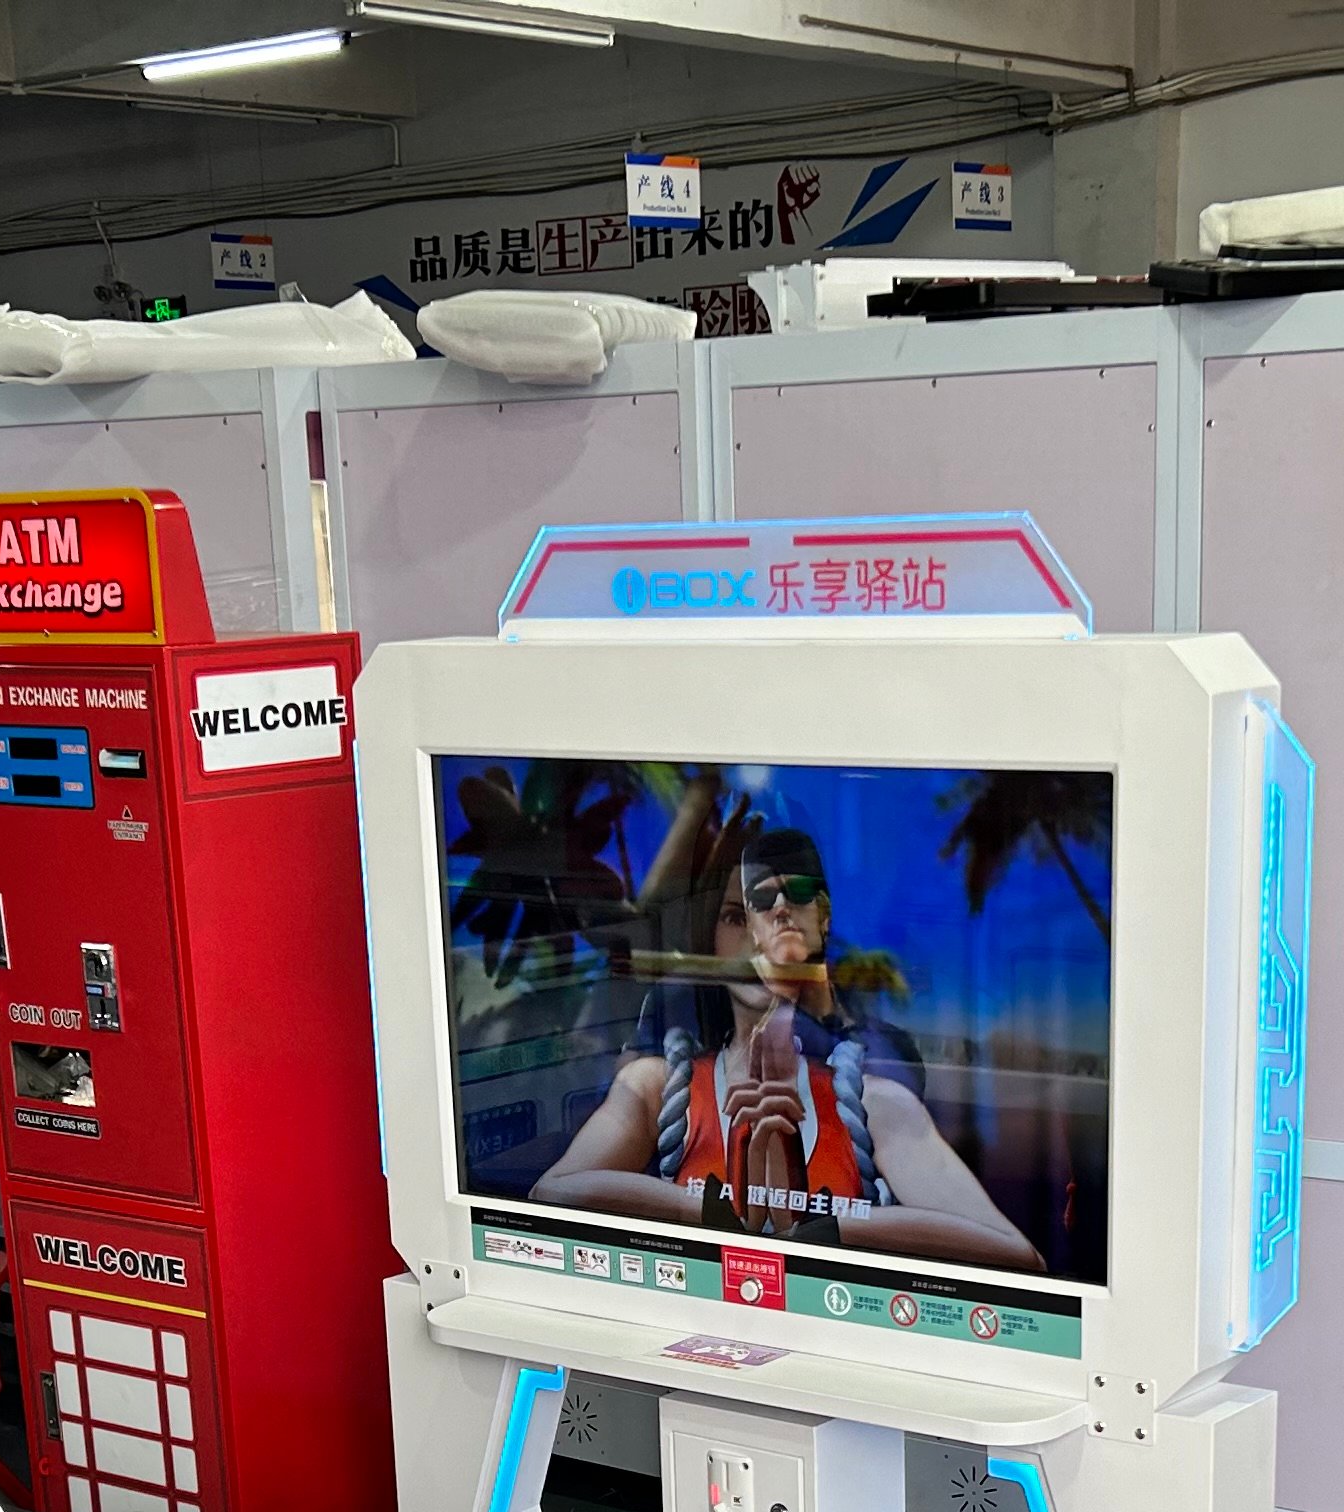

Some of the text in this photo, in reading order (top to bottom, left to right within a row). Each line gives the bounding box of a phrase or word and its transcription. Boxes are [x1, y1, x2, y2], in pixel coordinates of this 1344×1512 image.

[765, 556, 947, 615] 乐享驿站
[9, 686, 79, 708] EXCHANGE
[86, 688, 148, 710] MACHINE
[193, 699, 346, 738] WELCOME
[10, 1003, 81, 1030] COIN OUT
[17, 1112, 50, 1126] COLLECT
[719, 1183, 735, 1201] A
[34, 1234, 186, 1287] WELCOME
